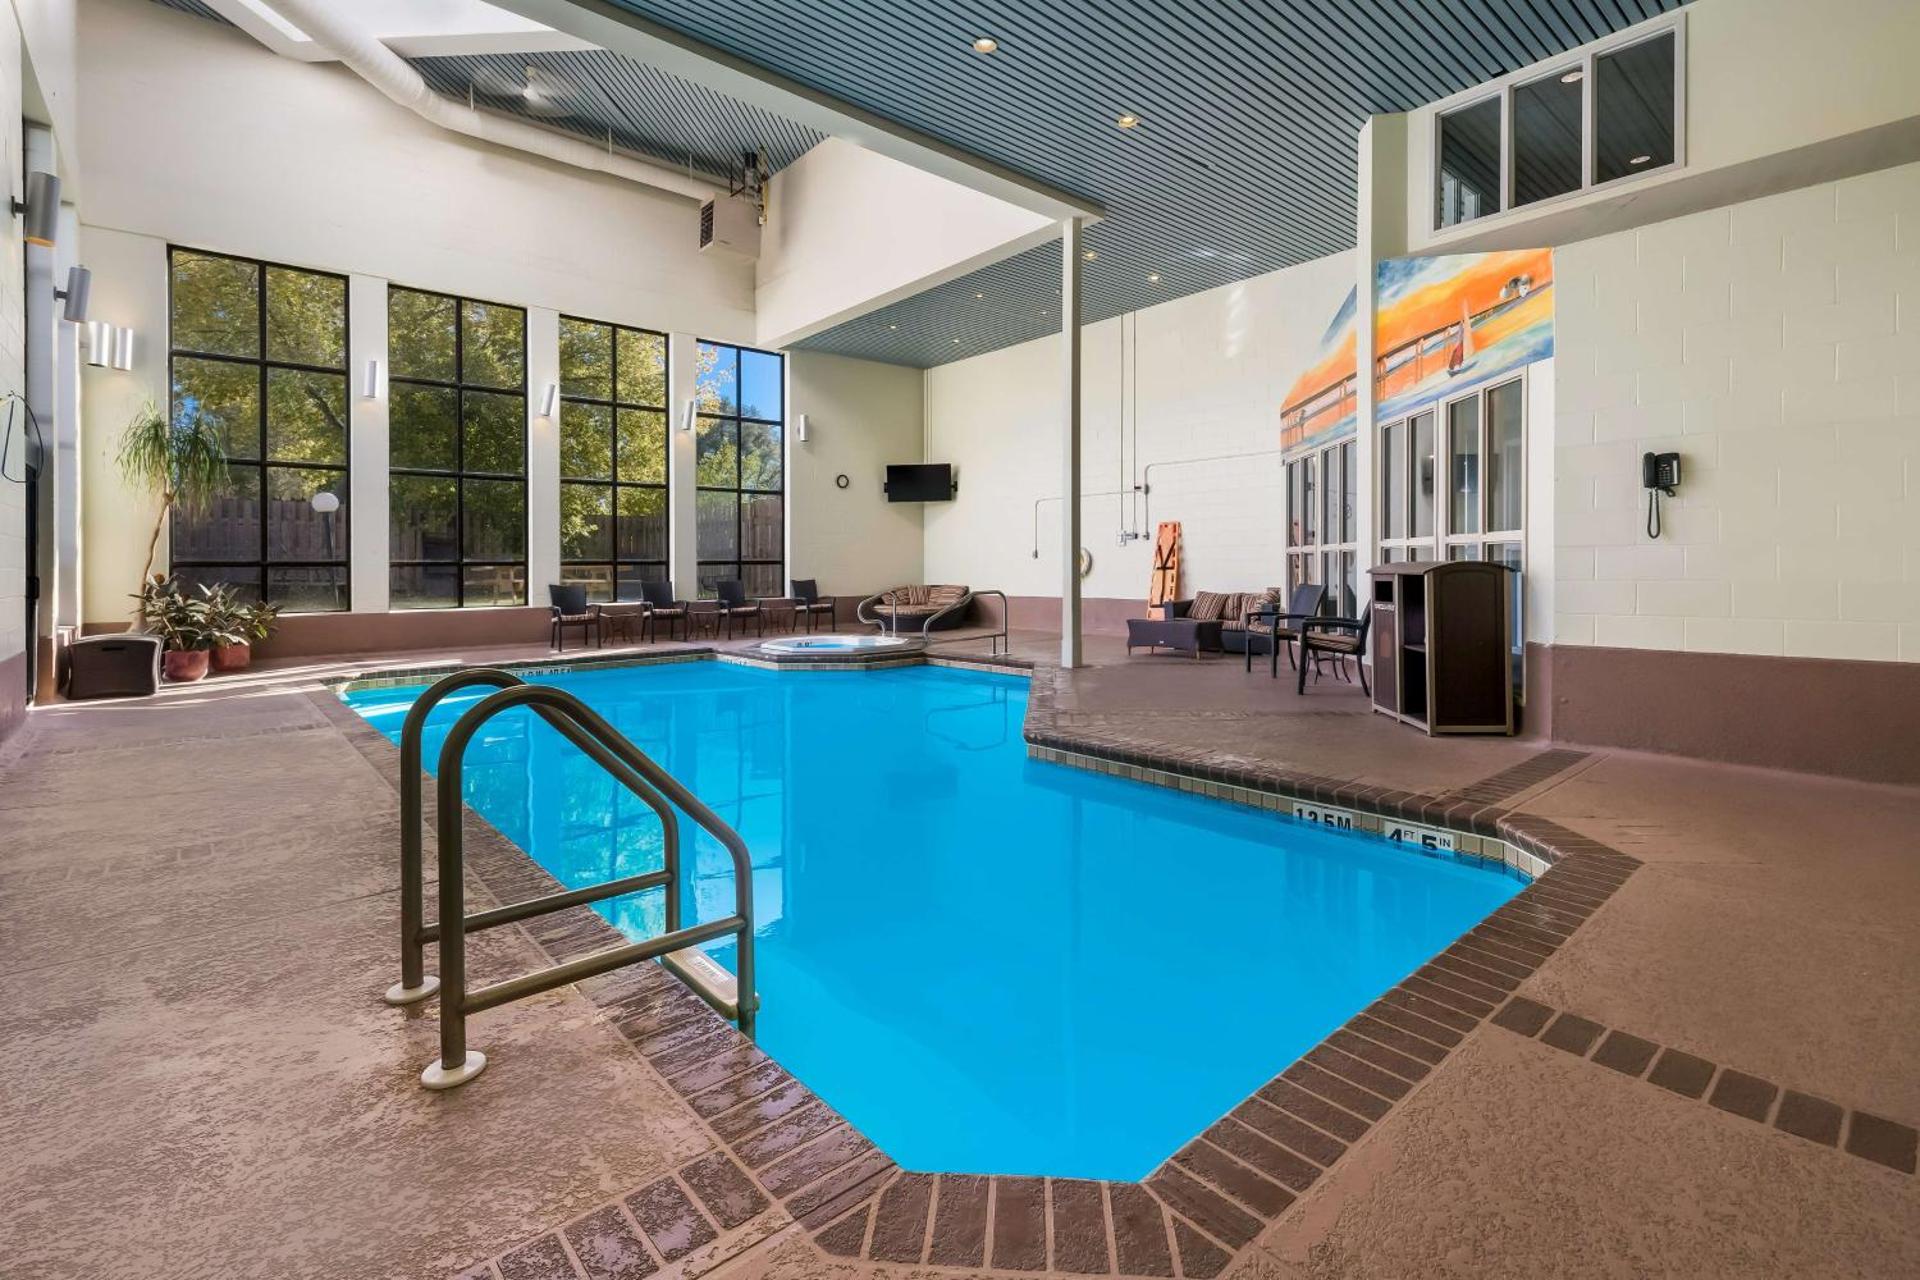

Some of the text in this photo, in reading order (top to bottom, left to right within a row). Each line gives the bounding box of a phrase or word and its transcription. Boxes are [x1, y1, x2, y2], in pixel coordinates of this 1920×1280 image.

[1390, 828, 1402, 842] 4
[1421, 834, 1438, 850] 5
[1439, 837, 1451, 848] IN
